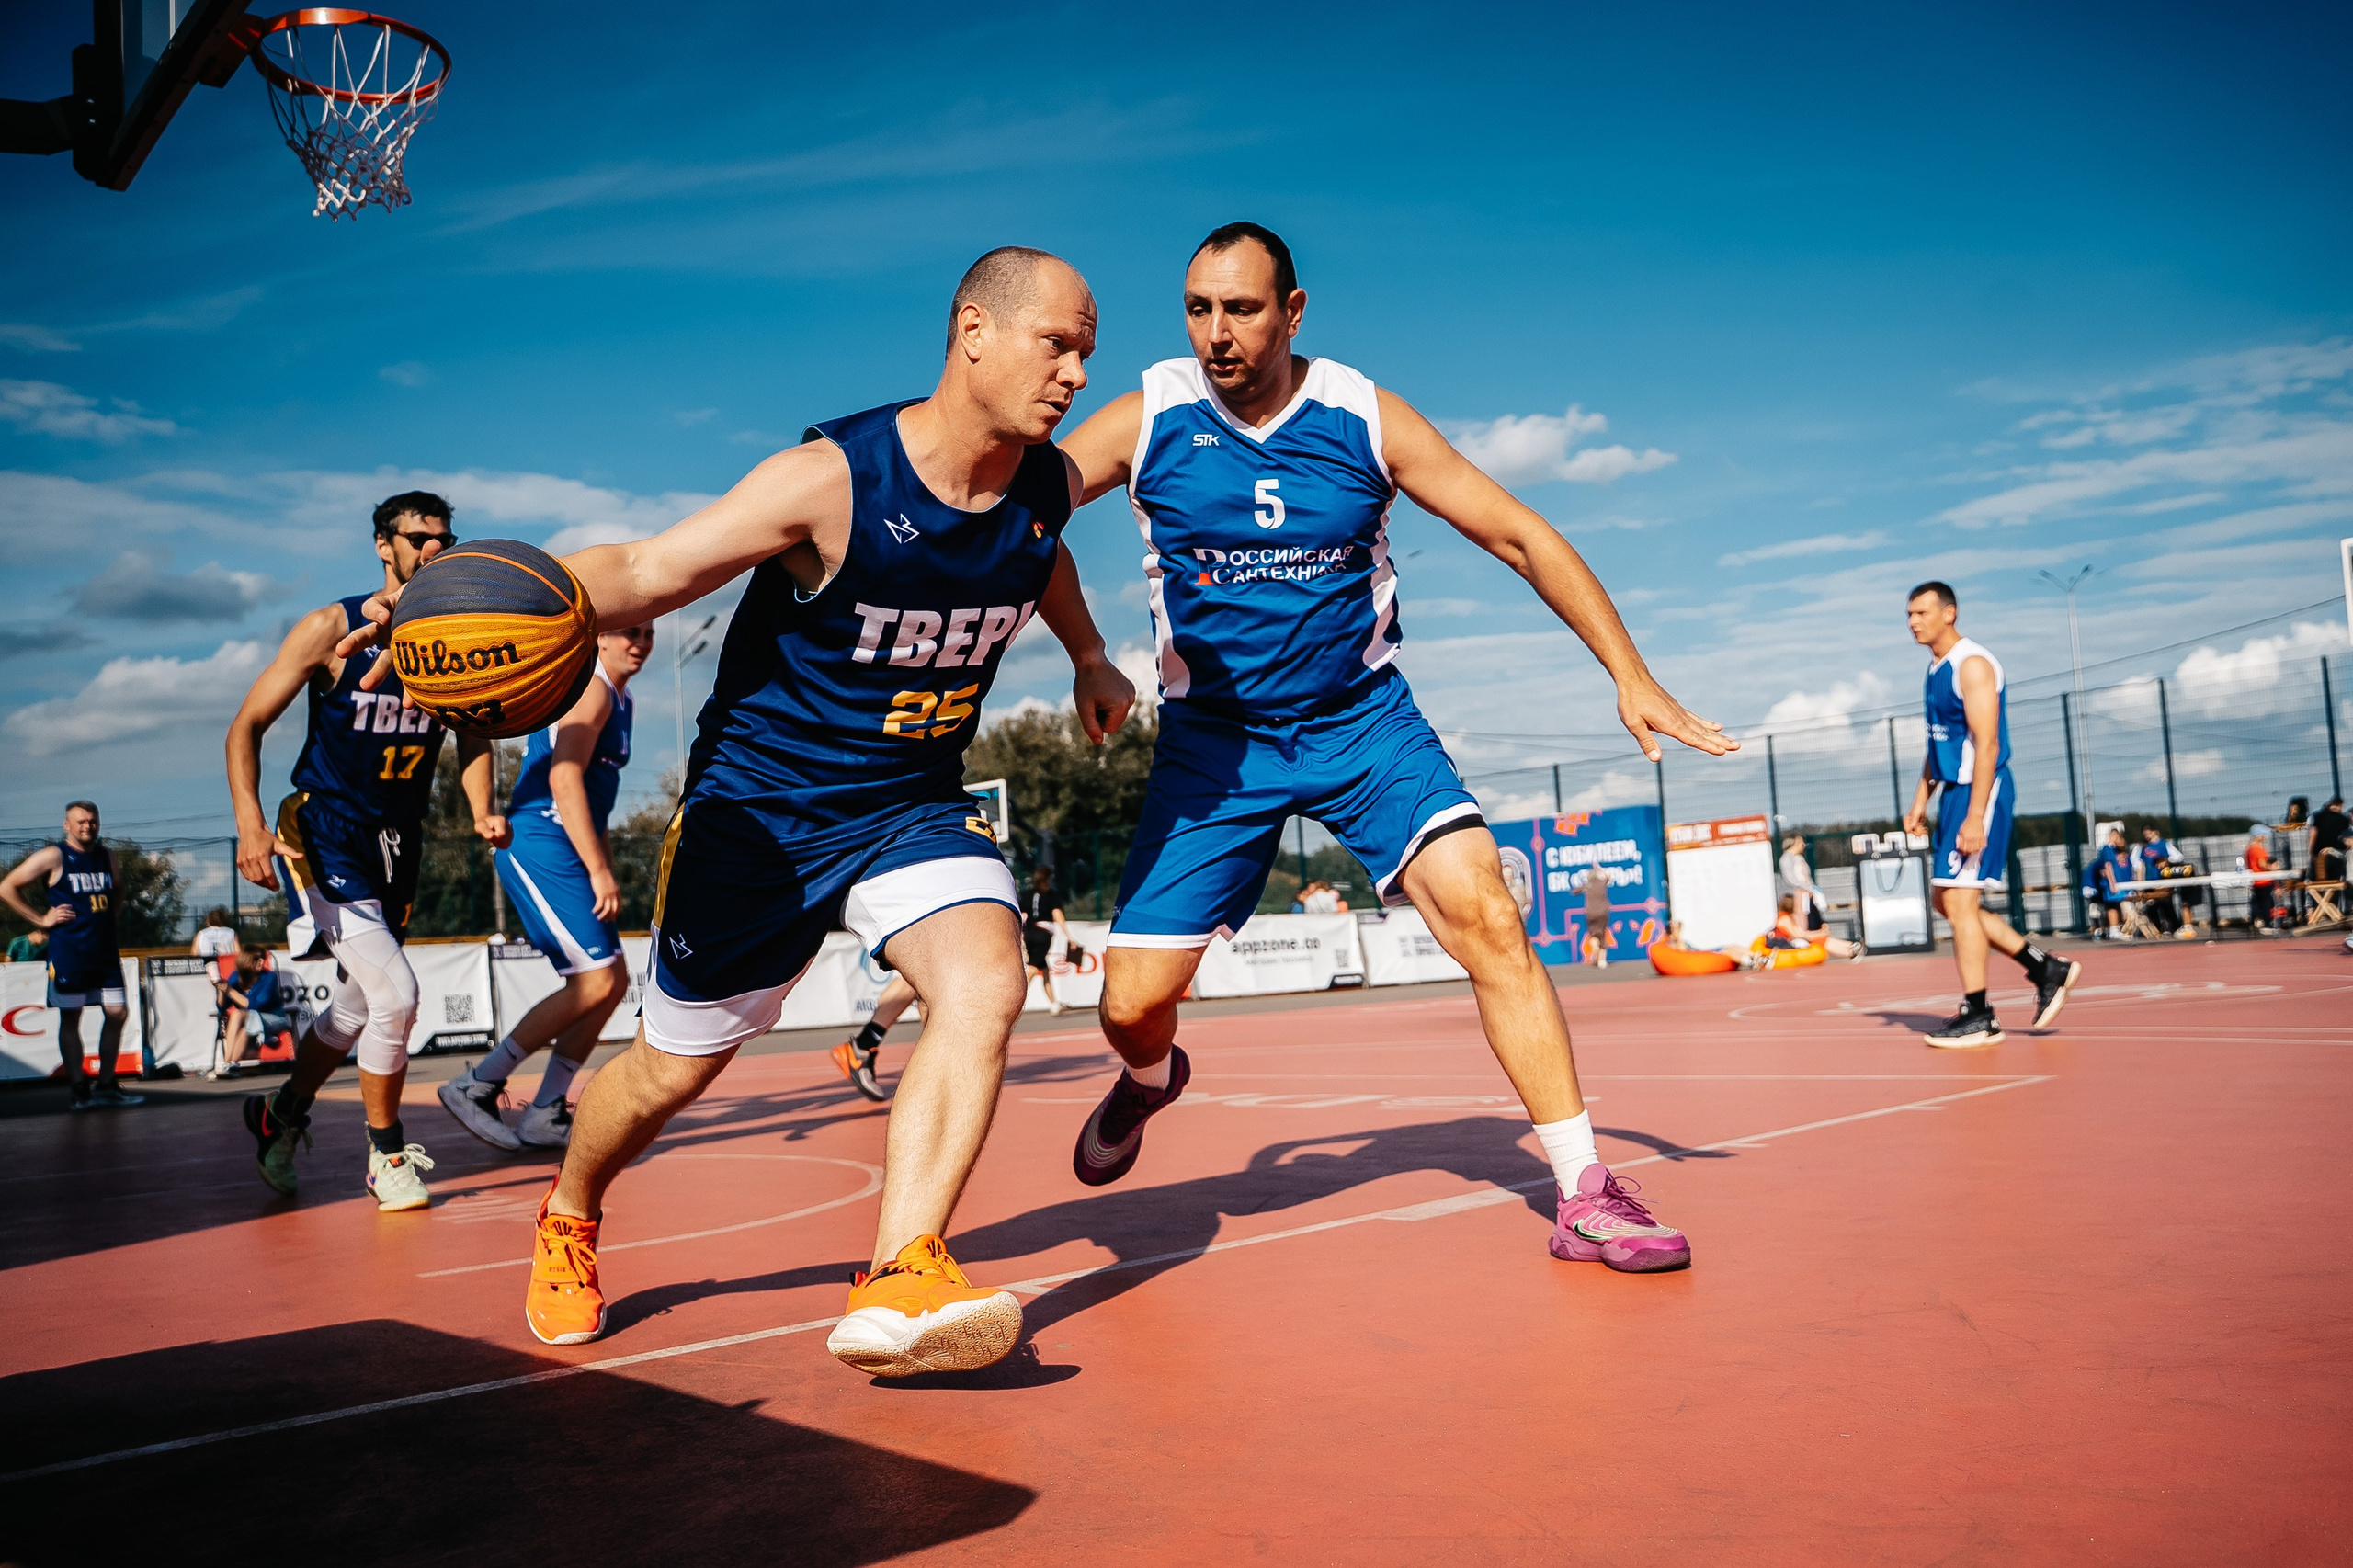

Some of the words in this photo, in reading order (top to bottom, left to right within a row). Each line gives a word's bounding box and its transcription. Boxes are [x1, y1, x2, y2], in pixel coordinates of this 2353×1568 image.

[1192, 434, 1221, 447] STK
[1254, 478, 1286, 529] 5
[1193, 546, 1354, 585] РОССИЙСКАЯ
[395, 640, 521, 676] Wilson
[350, 690, 448, 733] ТВЕ
[883, 683, 979, 739] 25
[379, 745, 425, 779] 17
